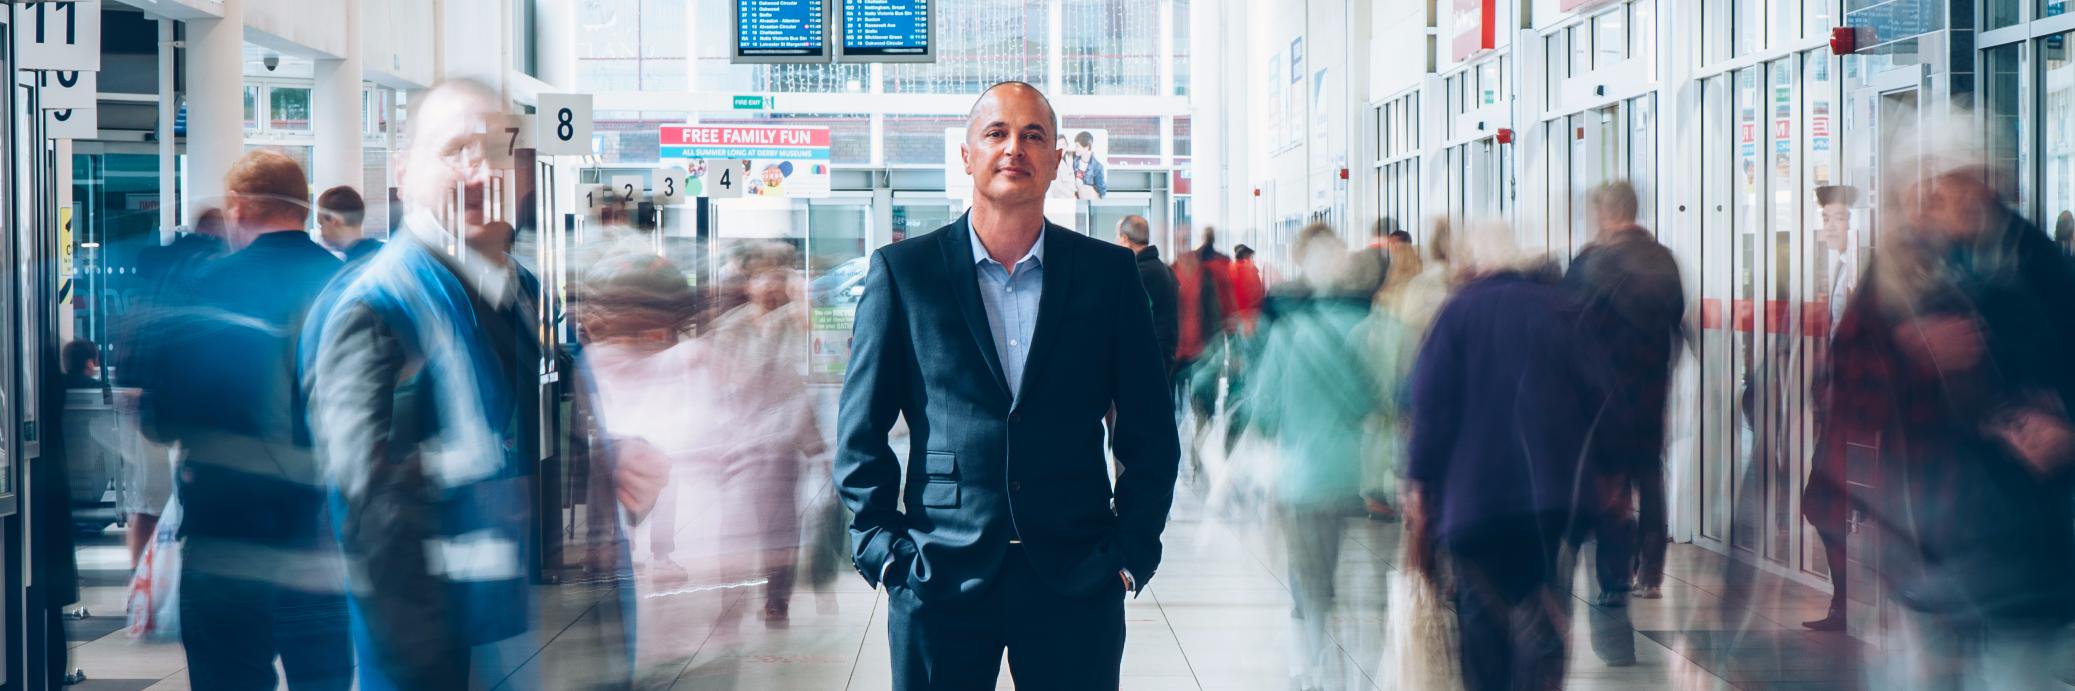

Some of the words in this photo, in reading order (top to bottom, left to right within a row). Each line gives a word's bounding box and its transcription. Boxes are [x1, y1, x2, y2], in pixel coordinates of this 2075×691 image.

[25, 1, 75, 45] 11
[557, 107, 574, 141] 8
[505, 127, 520, 156] 7
[682, 128, 719, 143] FREE
[723, 129, 775, 144] FAMILY
[780, 130, 811, 144] FUN
[664, 177, 674, 197] 3
[720, 168, 732, 190] 4
[586, 191, 593, 208] 1
[624, 184, 634, 201] 2
